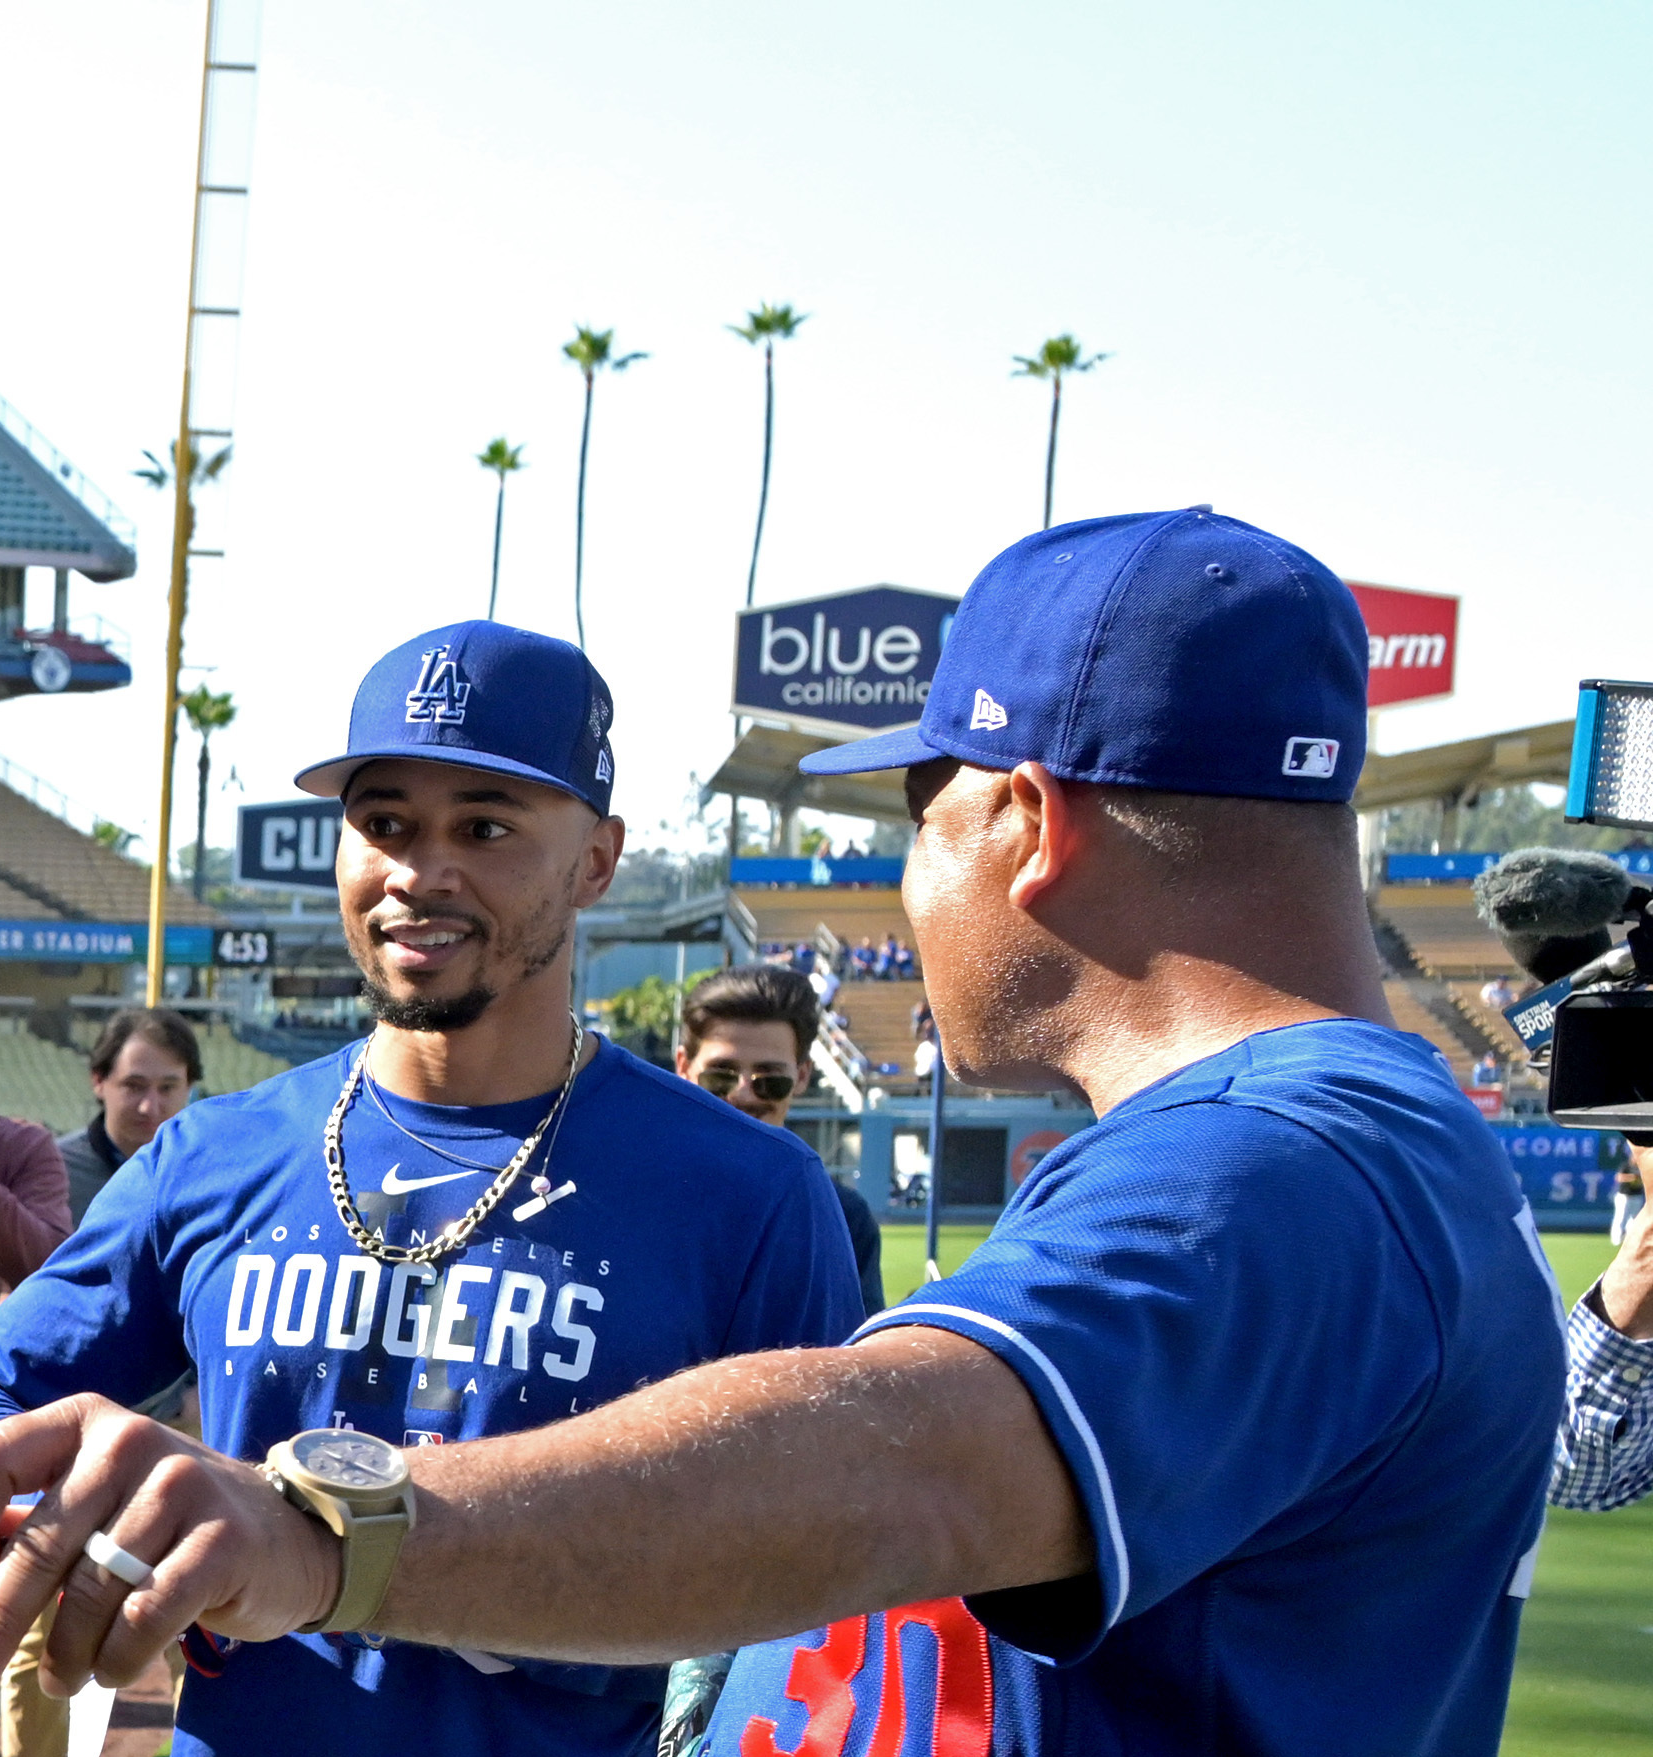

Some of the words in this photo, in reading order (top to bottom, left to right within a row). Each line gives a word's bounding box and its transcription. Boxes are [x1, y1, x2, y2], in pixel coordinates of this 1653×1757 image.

[759, 611, 922, 676] blue
[406, 643, 472, 725] LA
[260, 816, 343, 871] CU
[33, 931, 134, 954] STADIUM
[1518, 1004, 1557, 1041] SPOR
[1499, 1136, 1595, 1158] COME
[243, 1224, 322, 1244] LOS
[225, 1252, 605, 1382] DODGERS
[224, 1359, 579, 1414] BASEBALL
